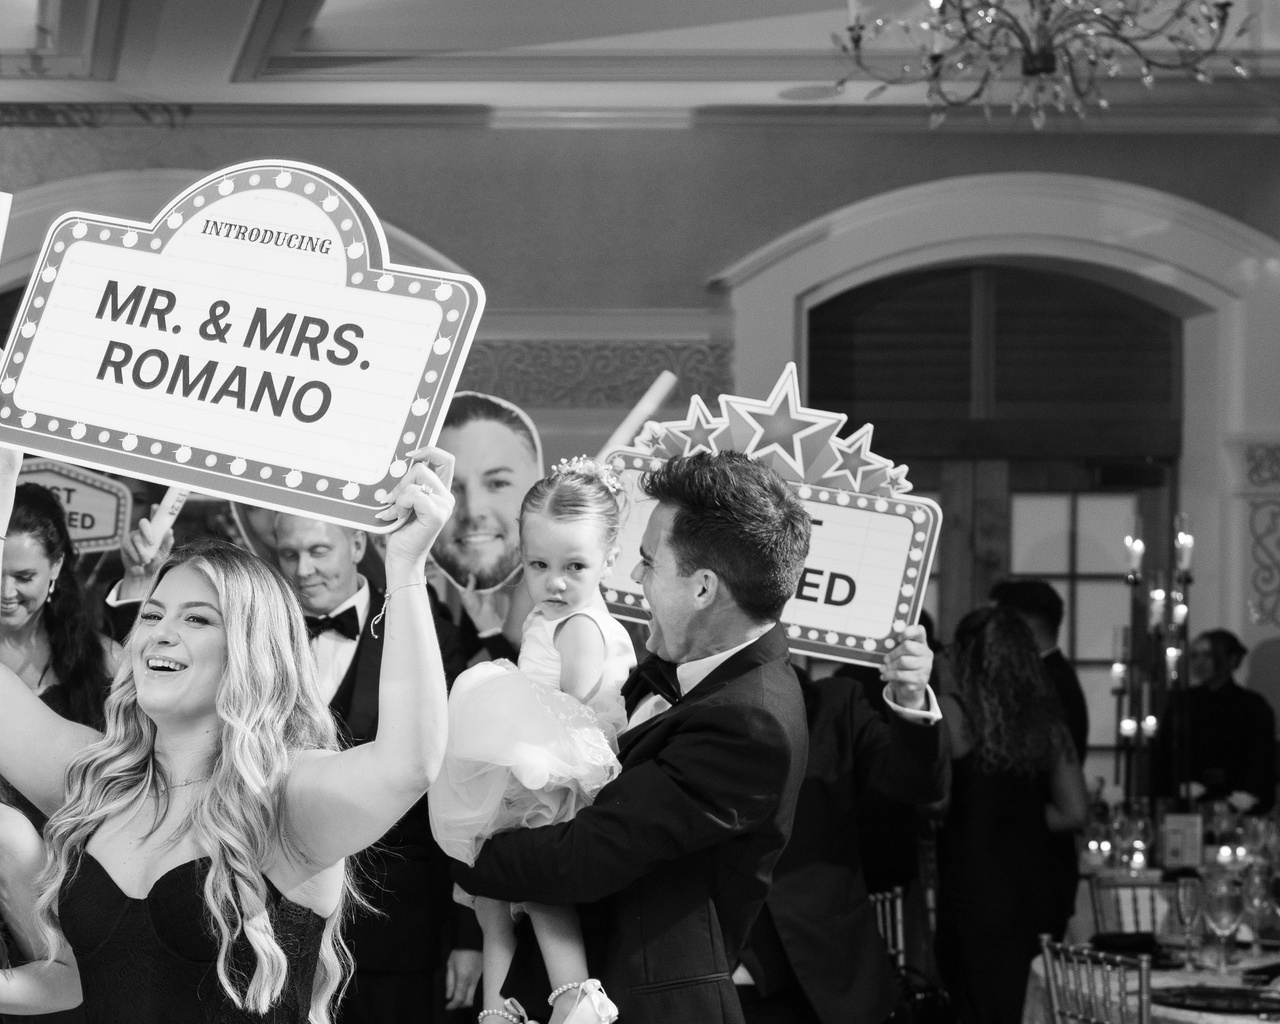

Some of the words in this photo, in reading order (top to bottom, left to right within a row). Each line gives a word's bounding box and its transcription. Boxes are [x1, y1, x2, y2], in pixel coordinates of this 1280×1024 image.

[201, 219, 333, 255] INTRODUCING
[95, 279, 182, 335] MR.
[198, 300, 233, 344] &
[242, 306, 370, 371] MRS.
[96, 340, 332, 424] ROMANO
[794, 567, 857, 607] ED
